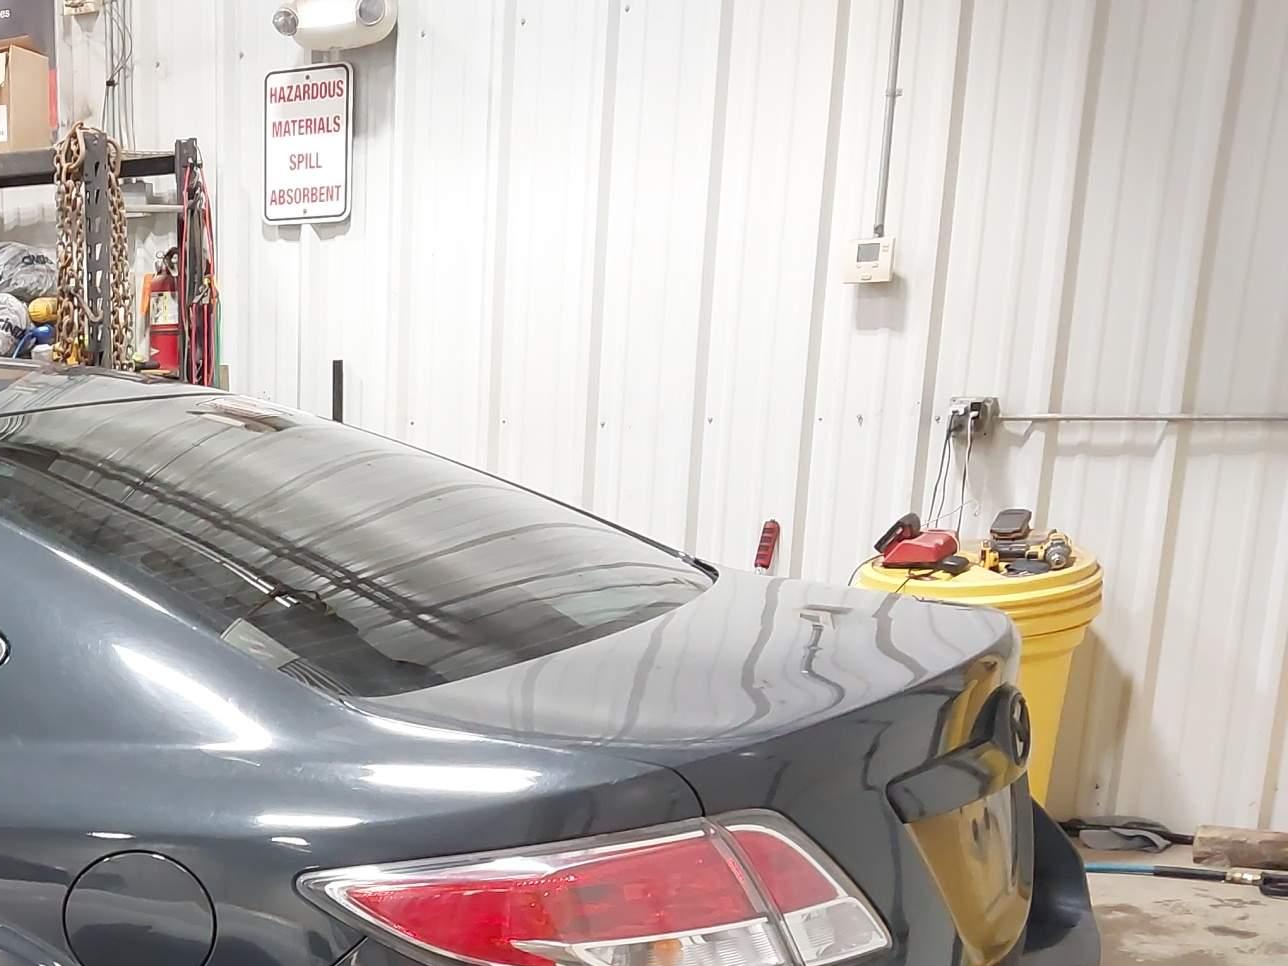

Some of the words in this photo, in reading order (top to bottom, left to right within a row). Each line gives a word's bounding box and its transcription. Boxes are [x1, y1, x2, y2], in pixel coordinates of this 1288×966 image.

[270, 80, 344, 104] HAZARDOUS
[271, 115, 341, 137] MATERIALS
[289, 152, 322, 171] SPILL
[269, 185, 342, 206] ABSORBENT
